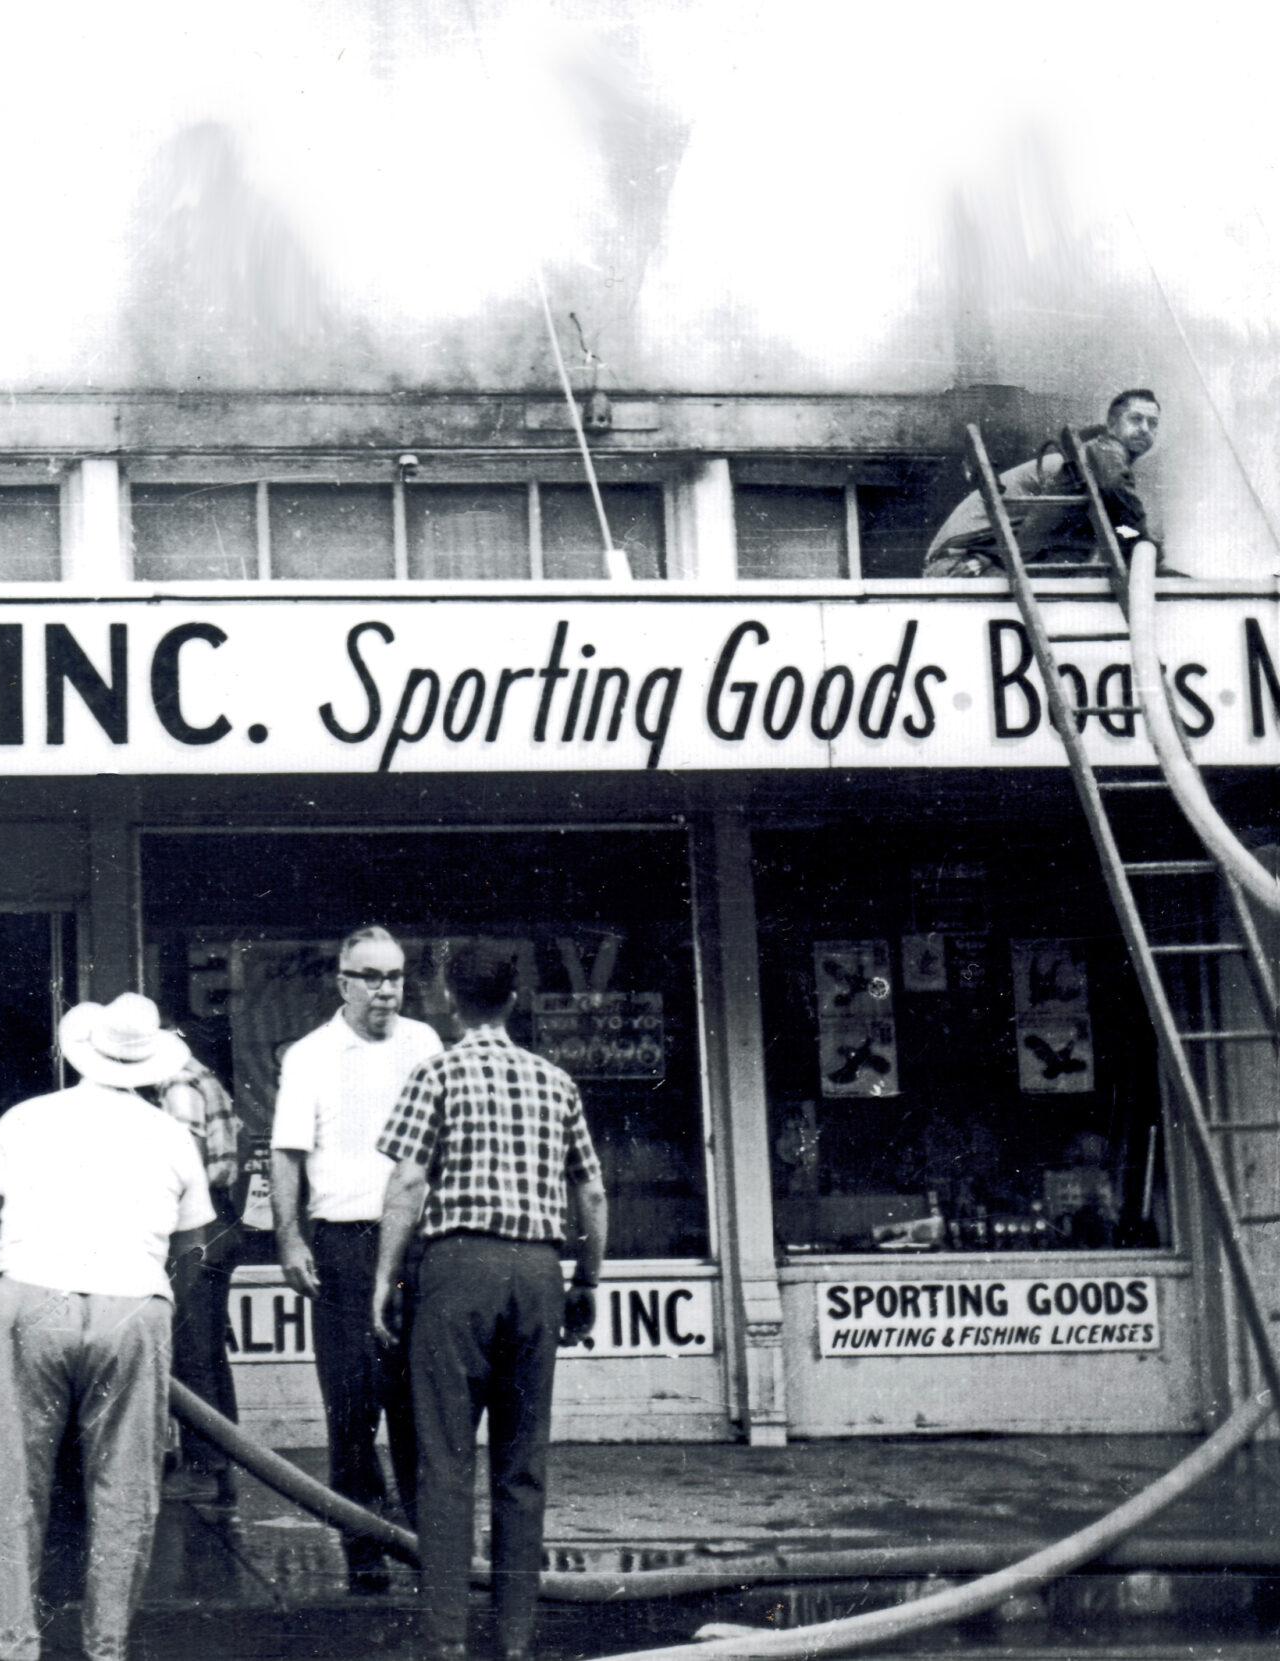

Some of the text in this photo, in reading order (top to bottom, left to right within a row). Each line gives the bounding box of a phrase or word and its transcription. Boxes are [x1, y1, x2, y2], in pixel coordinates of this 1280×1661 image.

[318, 620, 683, 772] Sporting
[705, 619, 947, 743] Goods
[989, 618, 1215, 738] Boas
[610, 1288, 705, 1349] INC.
[826, 1281, 1148, 1320] SPORTING GOODS
[832, 1322, 1155, 1349] HUNTING & FISHING LICENSES
